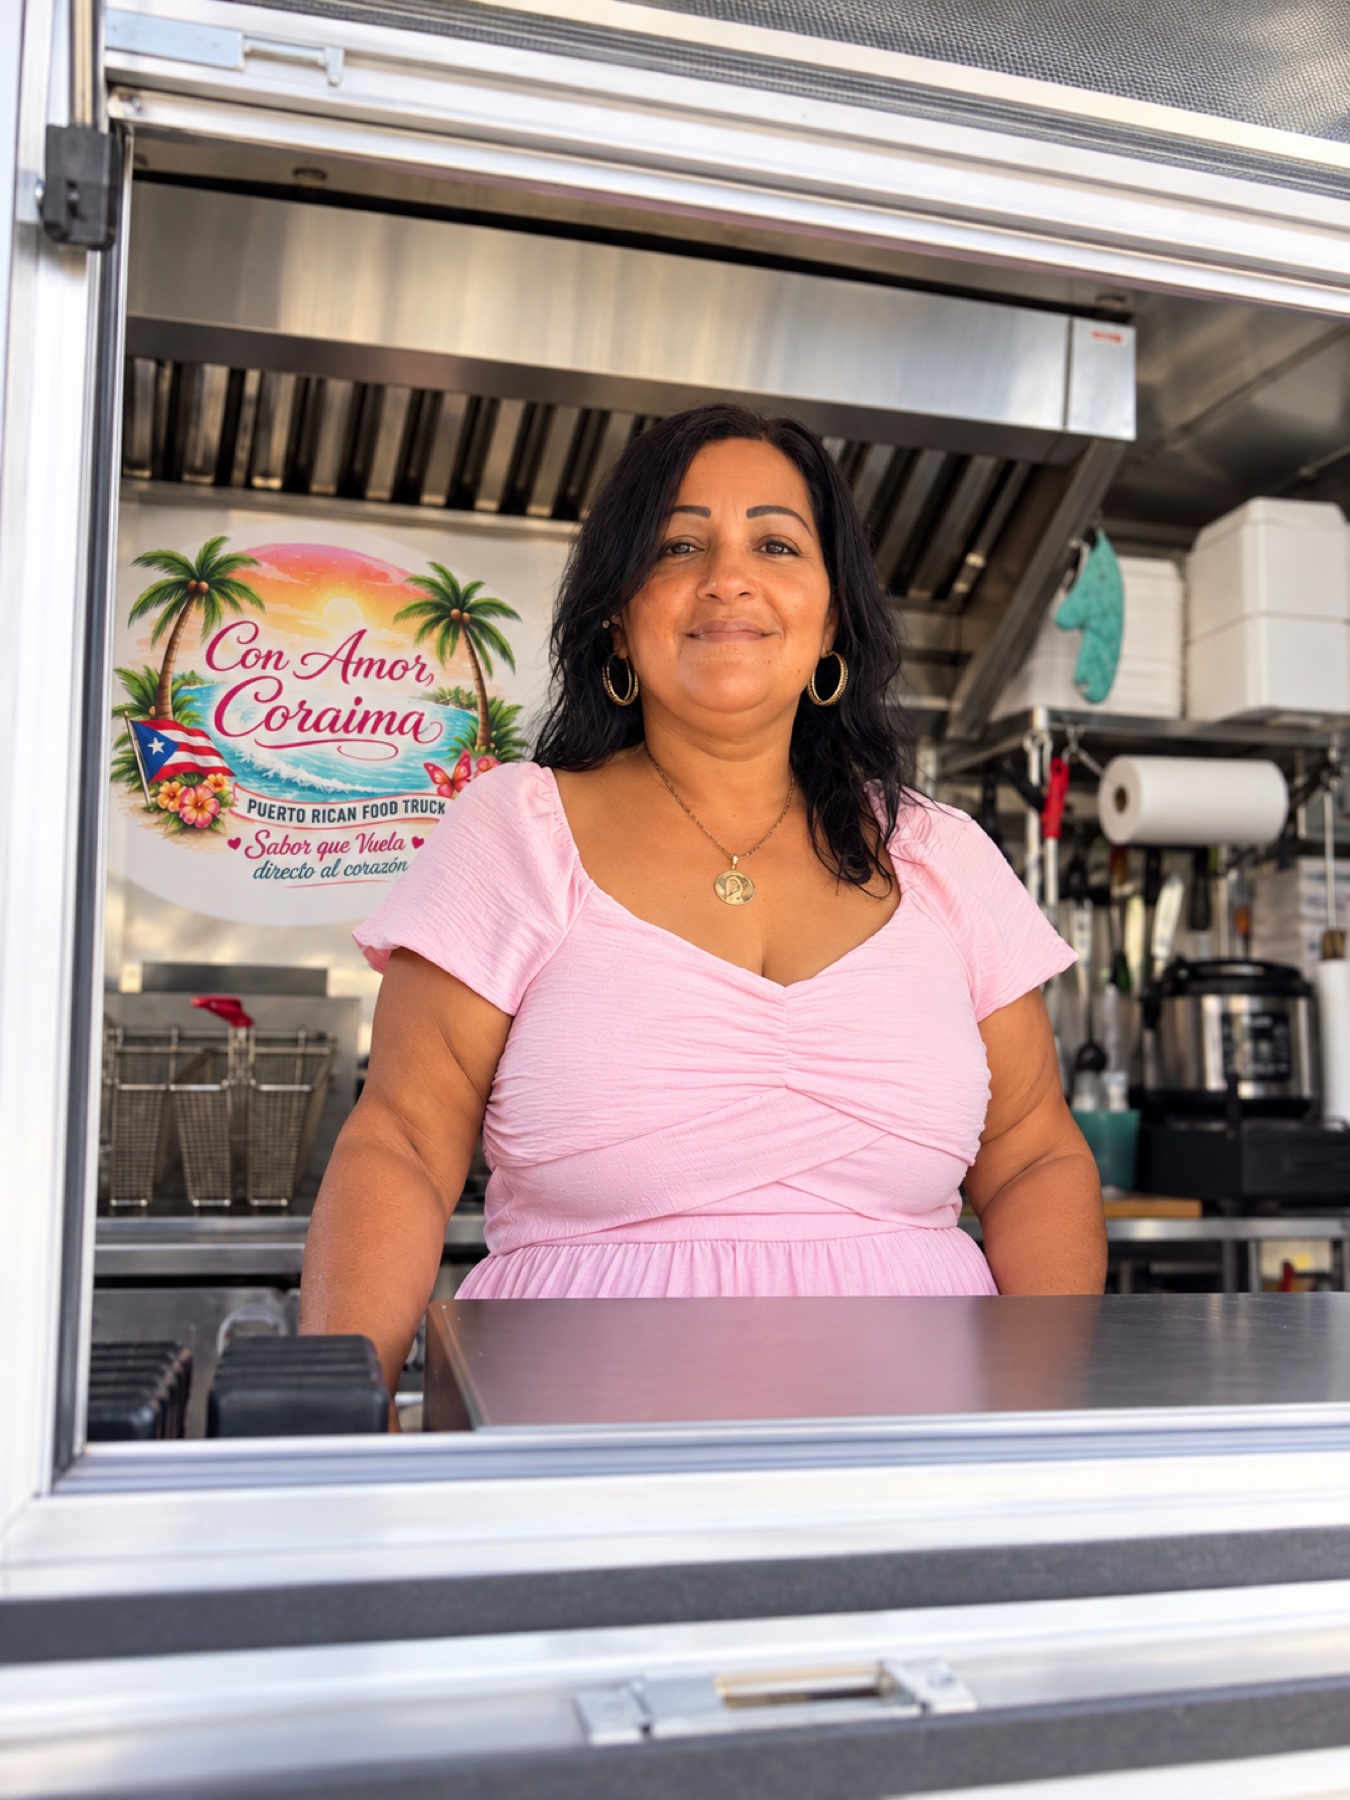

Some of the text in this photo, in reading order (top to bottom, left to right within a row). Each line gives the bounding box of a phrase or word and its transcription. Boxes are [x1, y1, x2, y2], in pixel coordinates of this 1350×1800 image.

[205, 620, 435, 686] Con Amor,
[214, 675, 443, 744] Coraima
[247, 799, 446, 823] PUERTO RICAN FOOD TRUCK
[244, 829, 405, 862] Sabor que Vuela
[252, 857, 409, 880] directo al corazón
